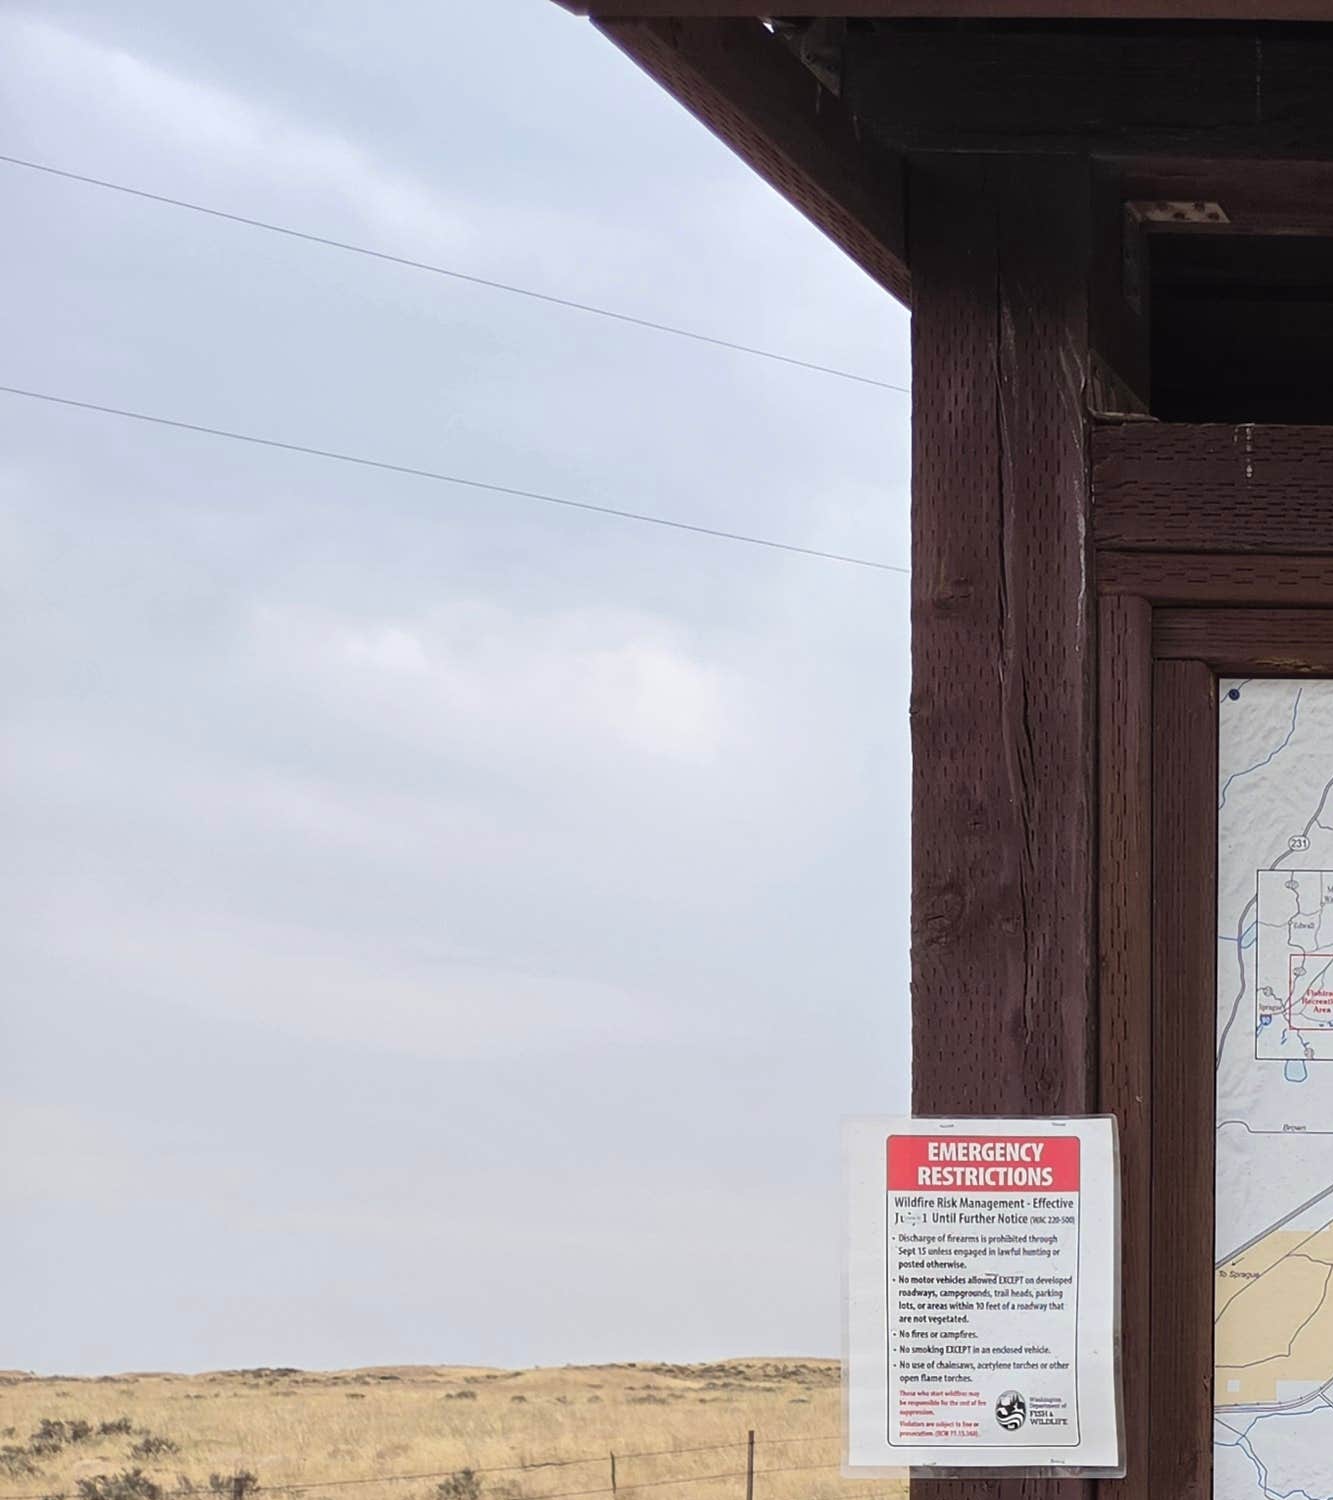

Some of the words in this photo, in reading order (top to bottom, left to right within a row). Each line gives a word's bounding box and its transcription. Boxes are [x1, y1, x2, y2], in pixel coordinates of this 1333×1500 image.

[928, 1142, 1044, 1161] EMERGENCY
[918, 1167, 1053, 1186] RESTRICTIONS
[895, 1197, 934, 1208] Wildfire
[937, 1198, 957, 1208] Risk
[960, 1198, 1024, 1211] Management
[1033, 1198, 1073, 1208] Effective
[932, 1213, 956, 1223] Until
[959, 1213, 995, 1223] Further
[998, 1213, 1027, 1223] Notice
[899, 1330, 910, 1339] No
[912, 1329, 928, 1339] fires
[940, 1330, 978, 1340] campfires.
